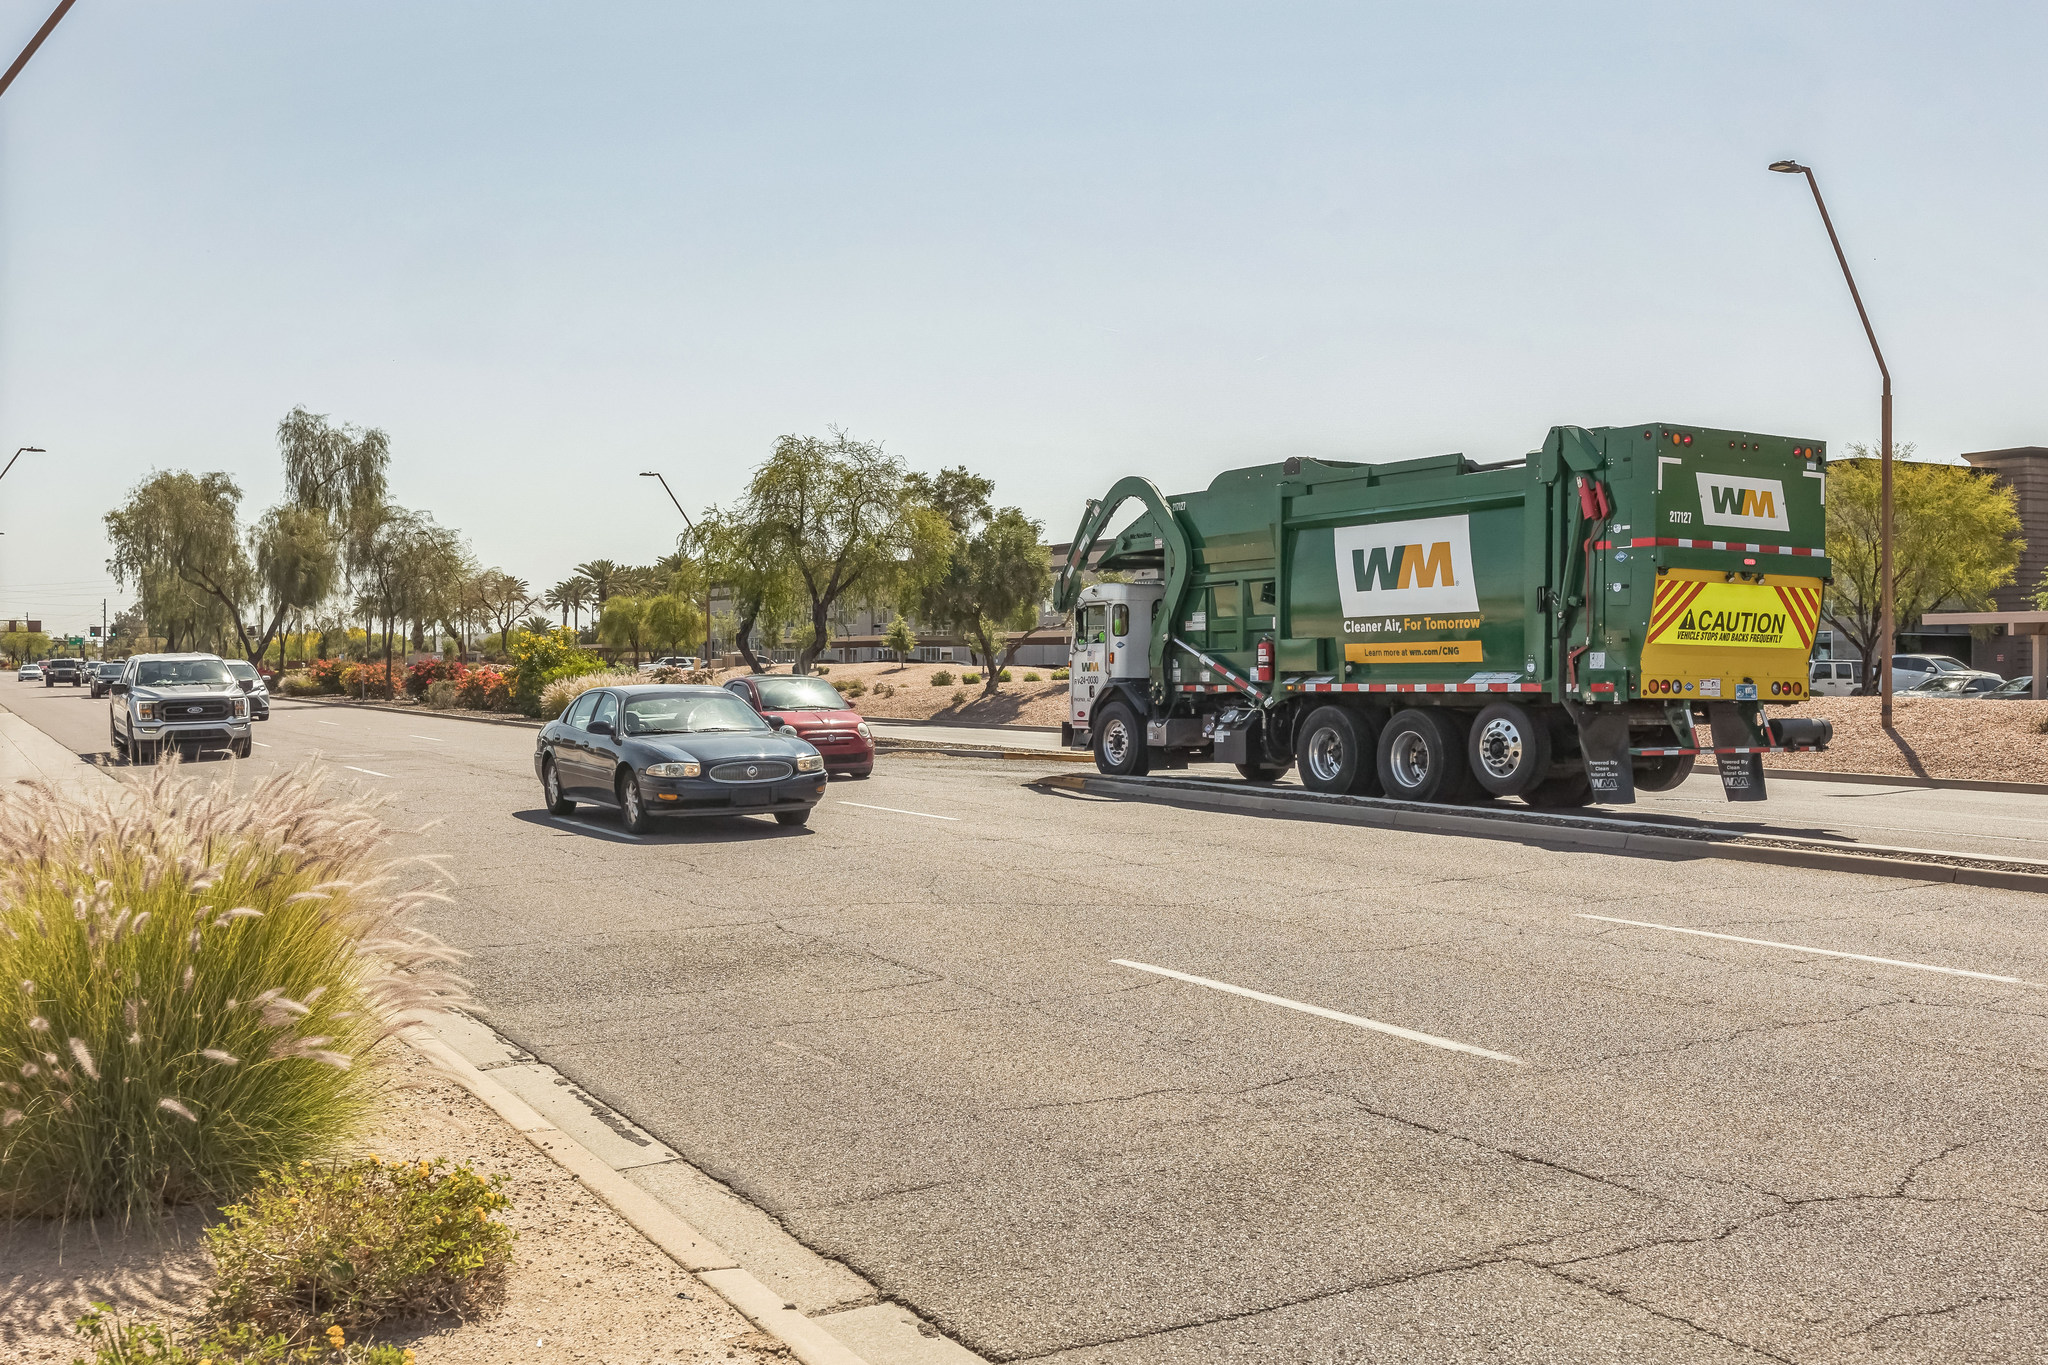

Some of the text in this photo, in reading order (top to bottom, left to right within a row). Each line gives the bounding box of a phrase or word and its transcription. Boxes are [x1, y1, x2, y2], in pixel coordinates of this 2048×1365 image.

[1711, 486, 1775, 518] WM
[1669, 511, 1692, 524] 217127
[1352, 541, 1455, 592] WM
[1343, 617, 1480, 633] Cleaner Air, For Tomorrow
[1698, 610, 1786, 634] CAUTION
[1677, 631, 1783, 643] VEHICLE STOPS AND BACKS FREQUENTLY
[1364, 648, 1383, 657] Learn
[1401, 648, 1408, 656] at
[1409, 646, 1460, 657] wm.com/CNG
[1082, 662, 1099, 672] WM
[1592, 779, 1617, 788] WM
[1723, 777, 1749, 786] WM
